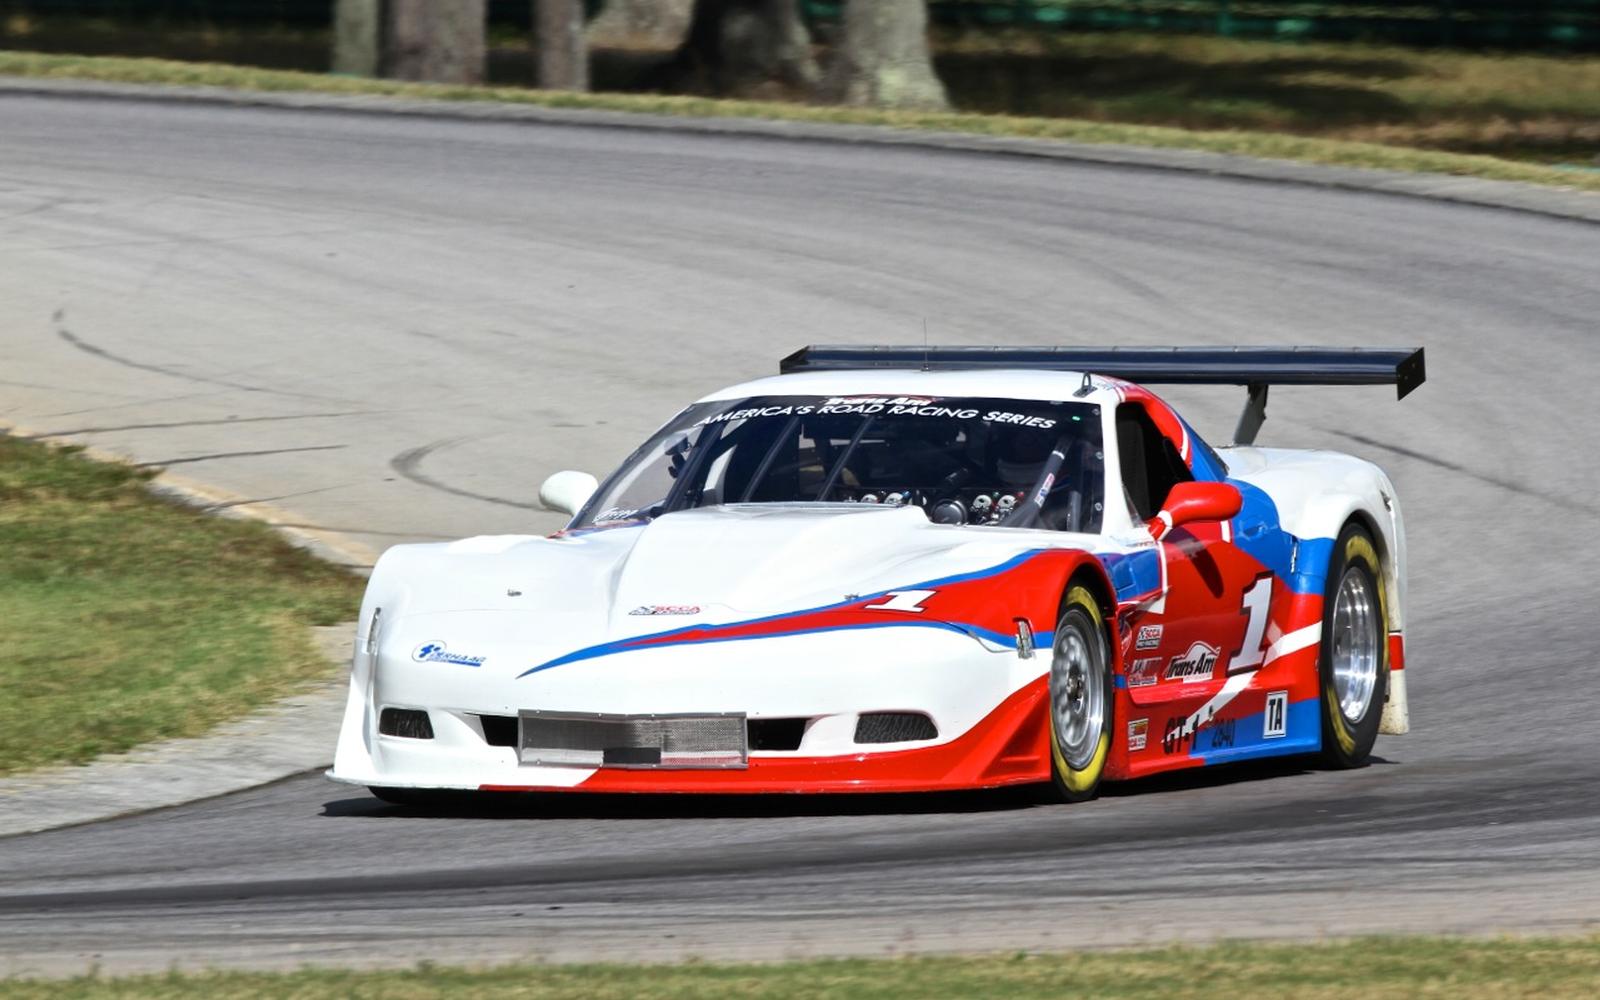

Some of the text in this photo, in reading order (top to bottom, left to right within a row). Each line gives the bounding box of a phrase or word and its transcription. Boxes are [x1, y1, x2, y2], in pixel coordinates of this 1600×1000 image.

[695, 404, 1056, 429] AMERICA'S ROAD RACING SERIES
[863, 589, 940, 613] 1
[1227, 571, 1274, 676] 1
[1267, 697, 1283, 732] TA
